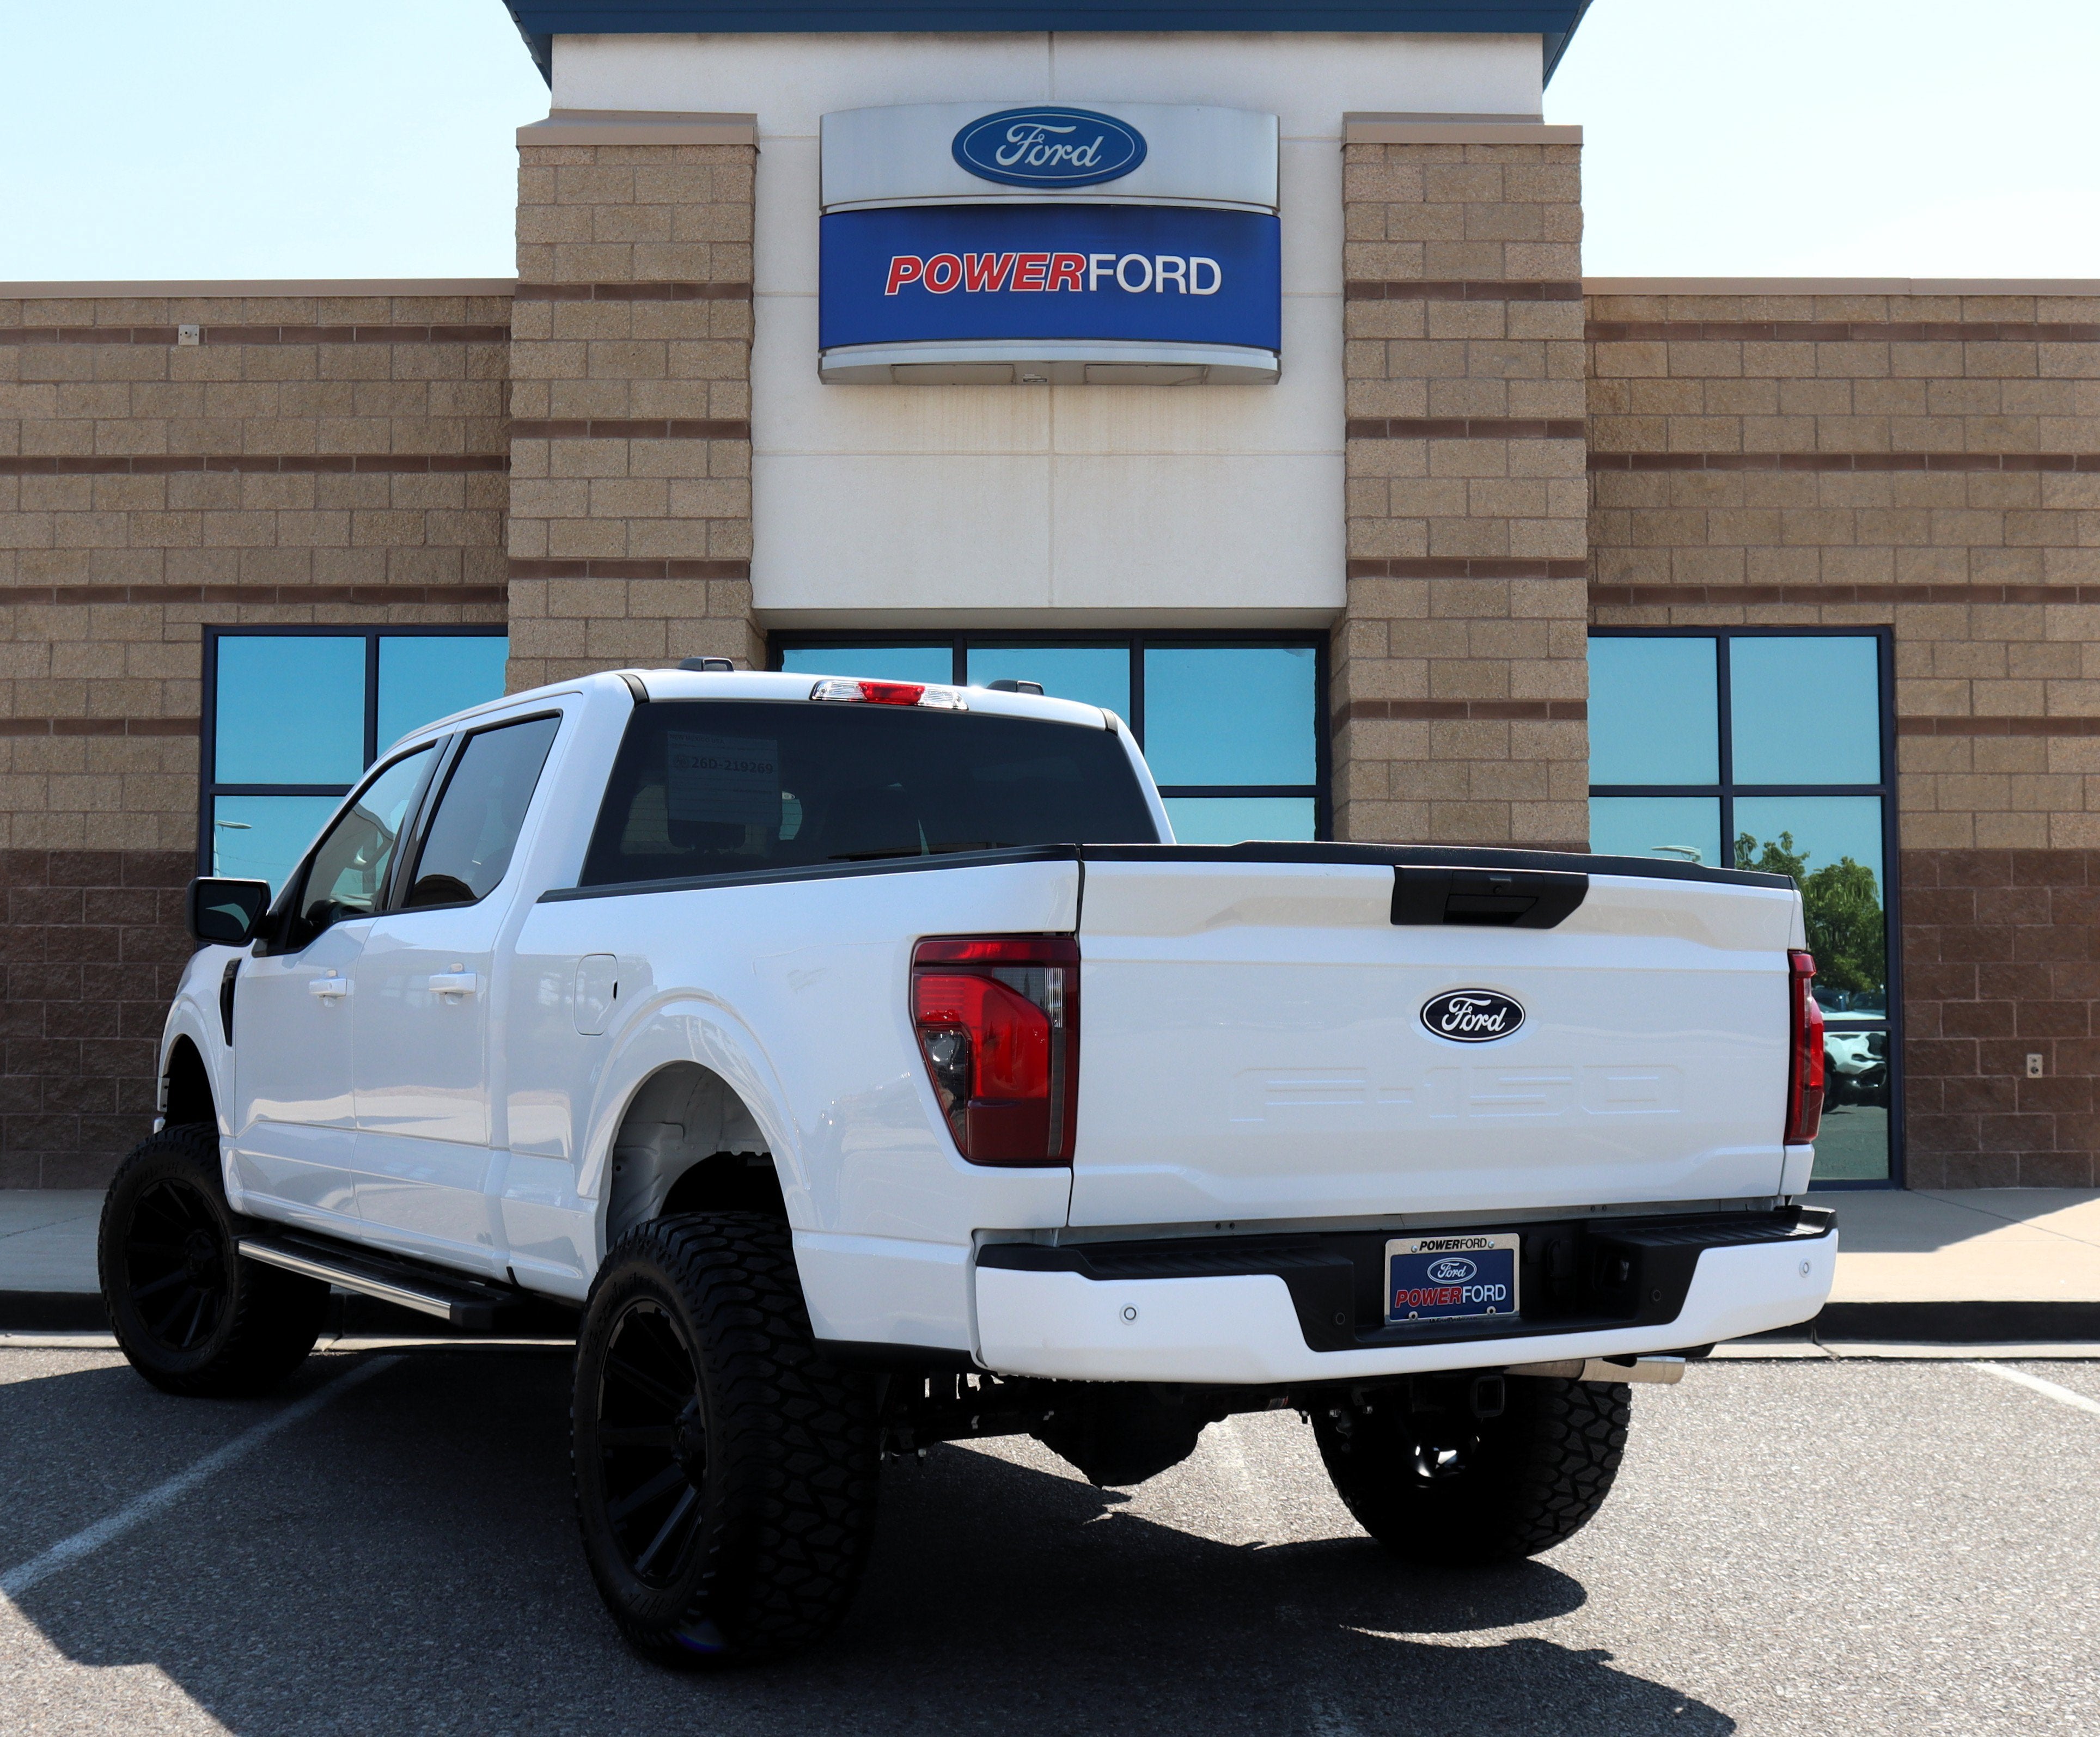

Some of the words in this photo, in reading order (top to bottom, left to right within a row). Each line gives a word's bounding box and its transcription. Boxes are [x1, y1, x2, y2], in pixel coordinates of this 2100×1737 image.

[995, 122, 1104, 167] Ford
[1441, 997, 1505, 1033] Ford
[1437, 1262, 1467, 1279] Ford
